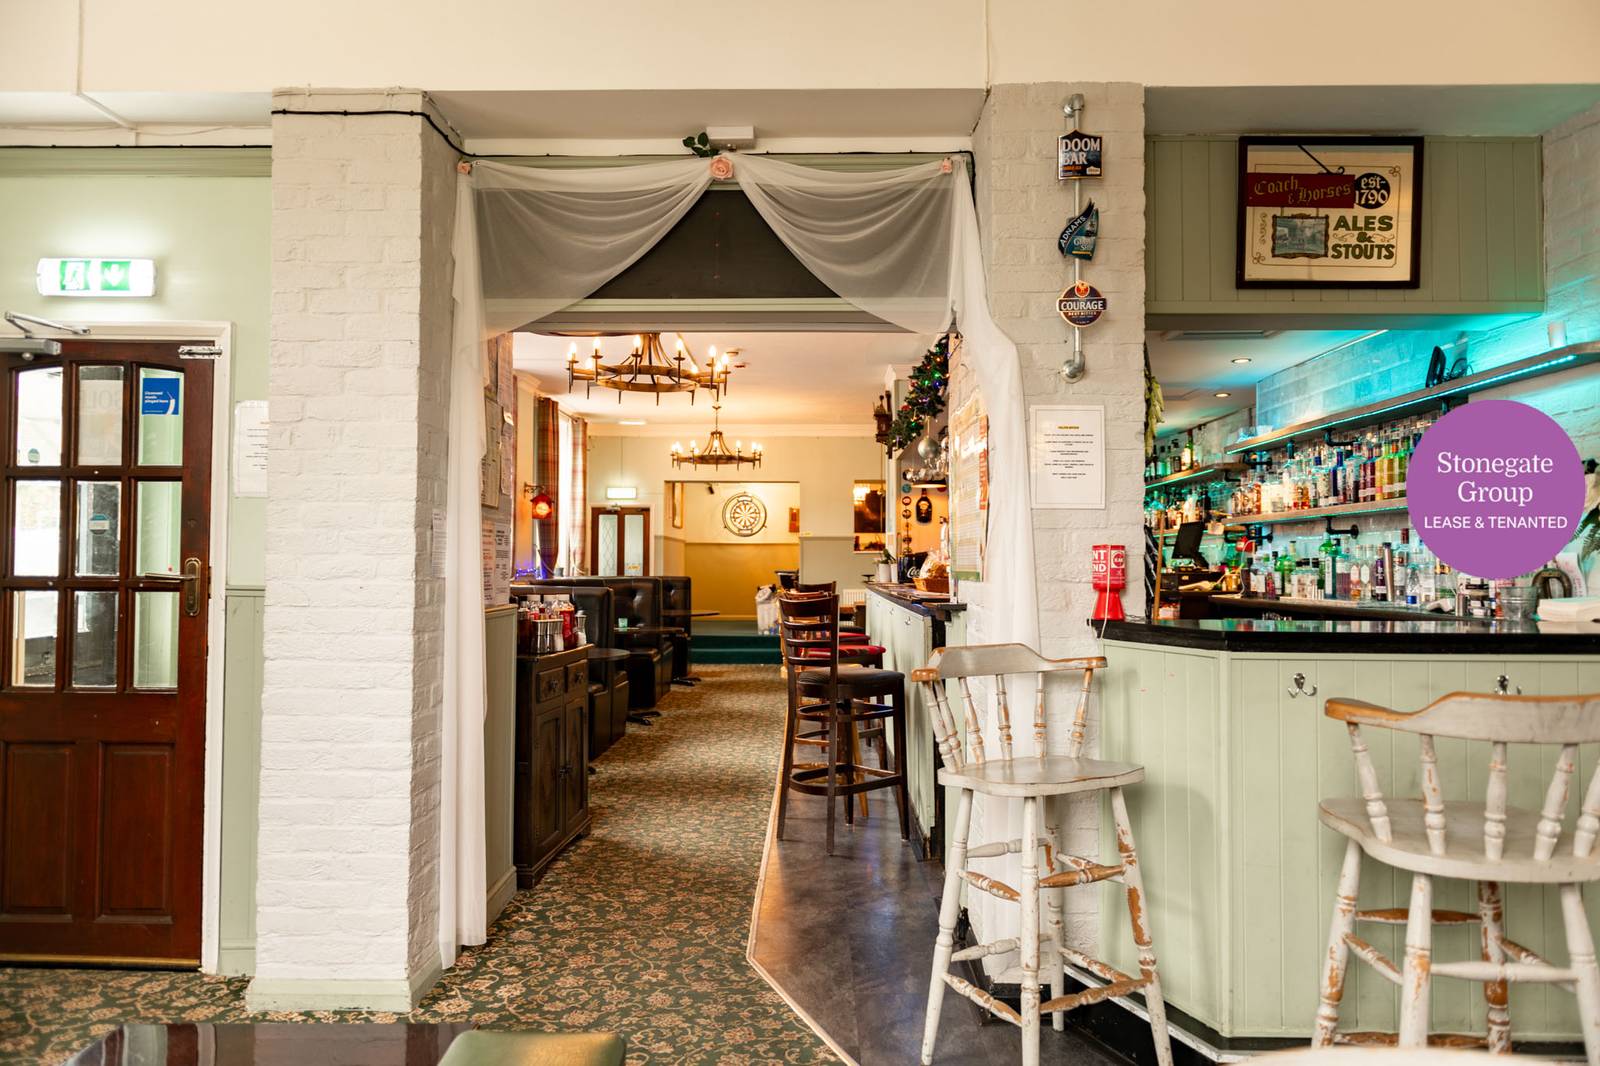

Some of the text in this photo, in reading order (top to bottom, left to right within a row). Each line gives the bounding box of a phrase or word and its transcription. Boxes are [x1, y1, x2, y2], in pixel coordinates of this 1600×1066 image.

[1062, 138, 1101, 152] DOOM
[1062, 152, 1088, 165] BAR
[1254, 176, 1298, 195] Coach
[1355, 189, 1388, 205] 1790
[1333, 215, 1393, 231] ALES
[1060, 215, 1087, 248] ADNAMS
[1356, 231, 1375, 243] &
[1331, 243, 1395, 260] STOUTS
[1061, 300, 1104, 311] COURAGE
